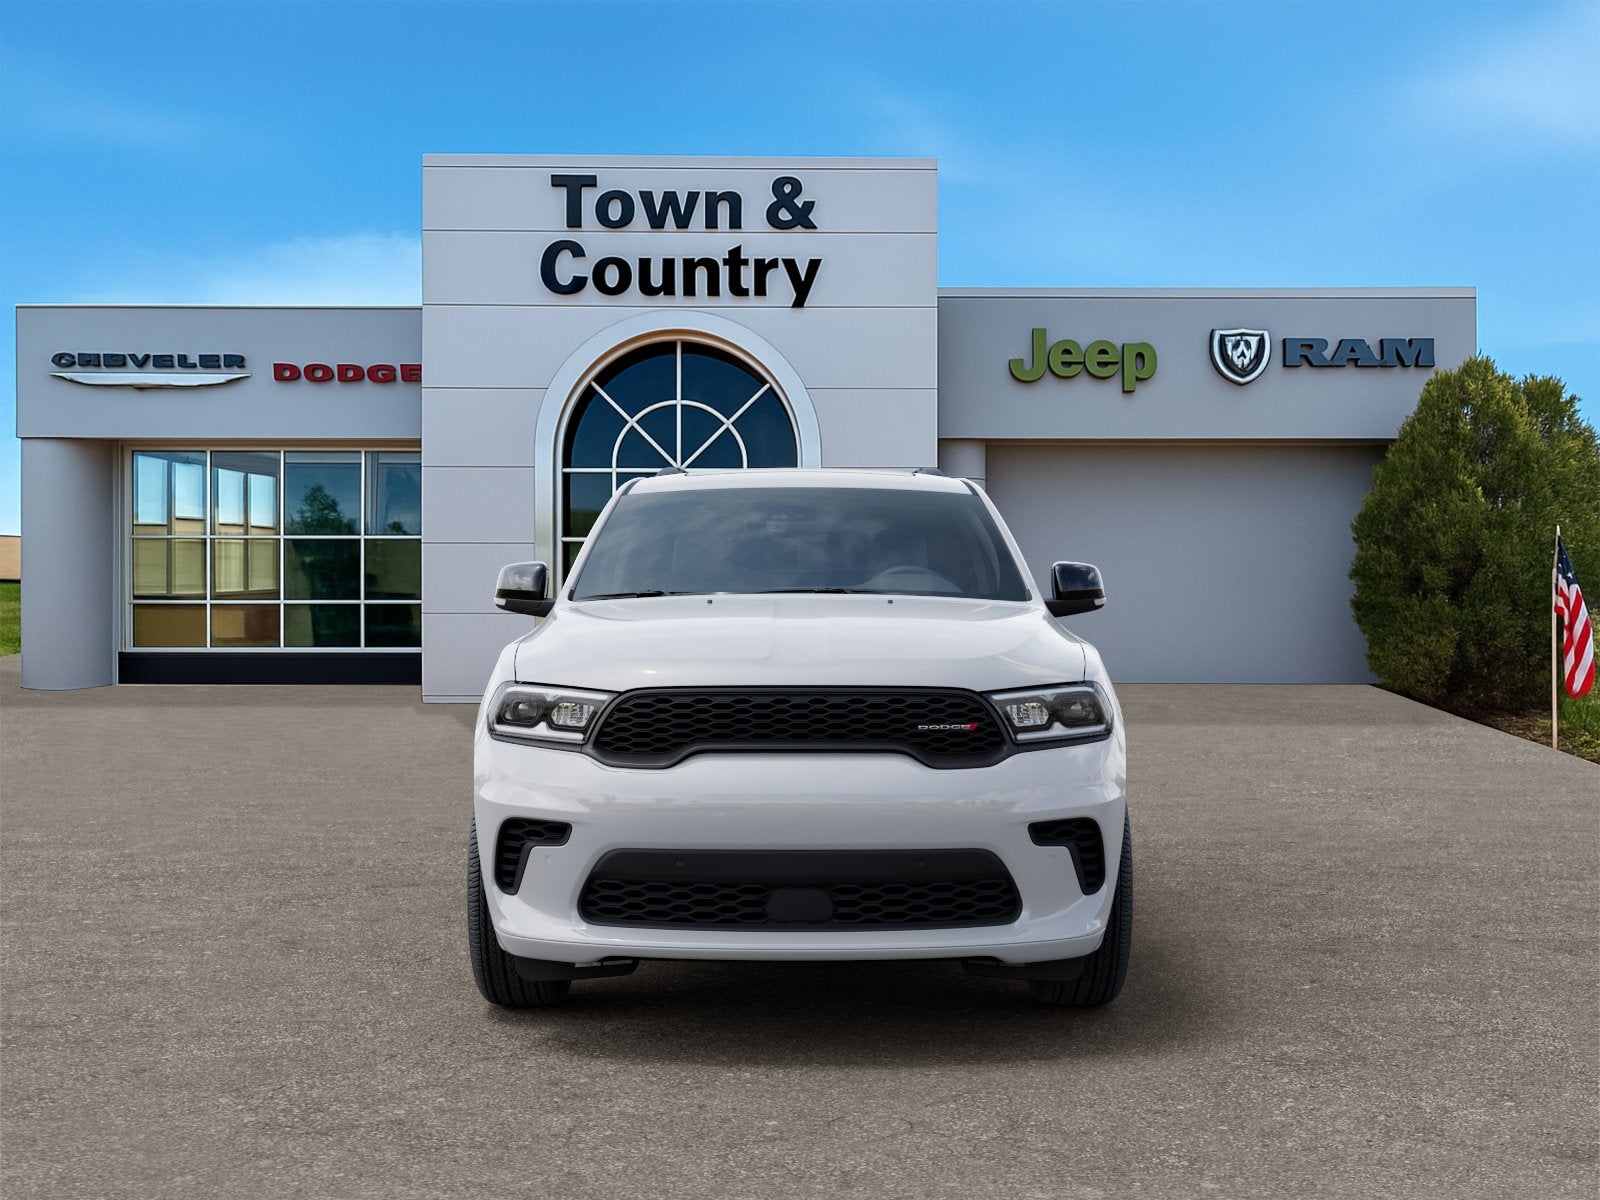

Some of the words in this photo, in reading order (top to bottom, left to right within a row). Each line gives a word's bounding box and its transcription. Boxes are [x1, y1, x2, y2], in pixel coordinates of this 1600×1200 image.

[551, 174, 742, 229] Town
[766, 176, 818, 230] &
[540, 239, 822, 308] Country
[273, 363, 422, 383] DODGE
[1009, 328, 1157, 393] Jeep
[1283, 337, 1436, 368] RAM
